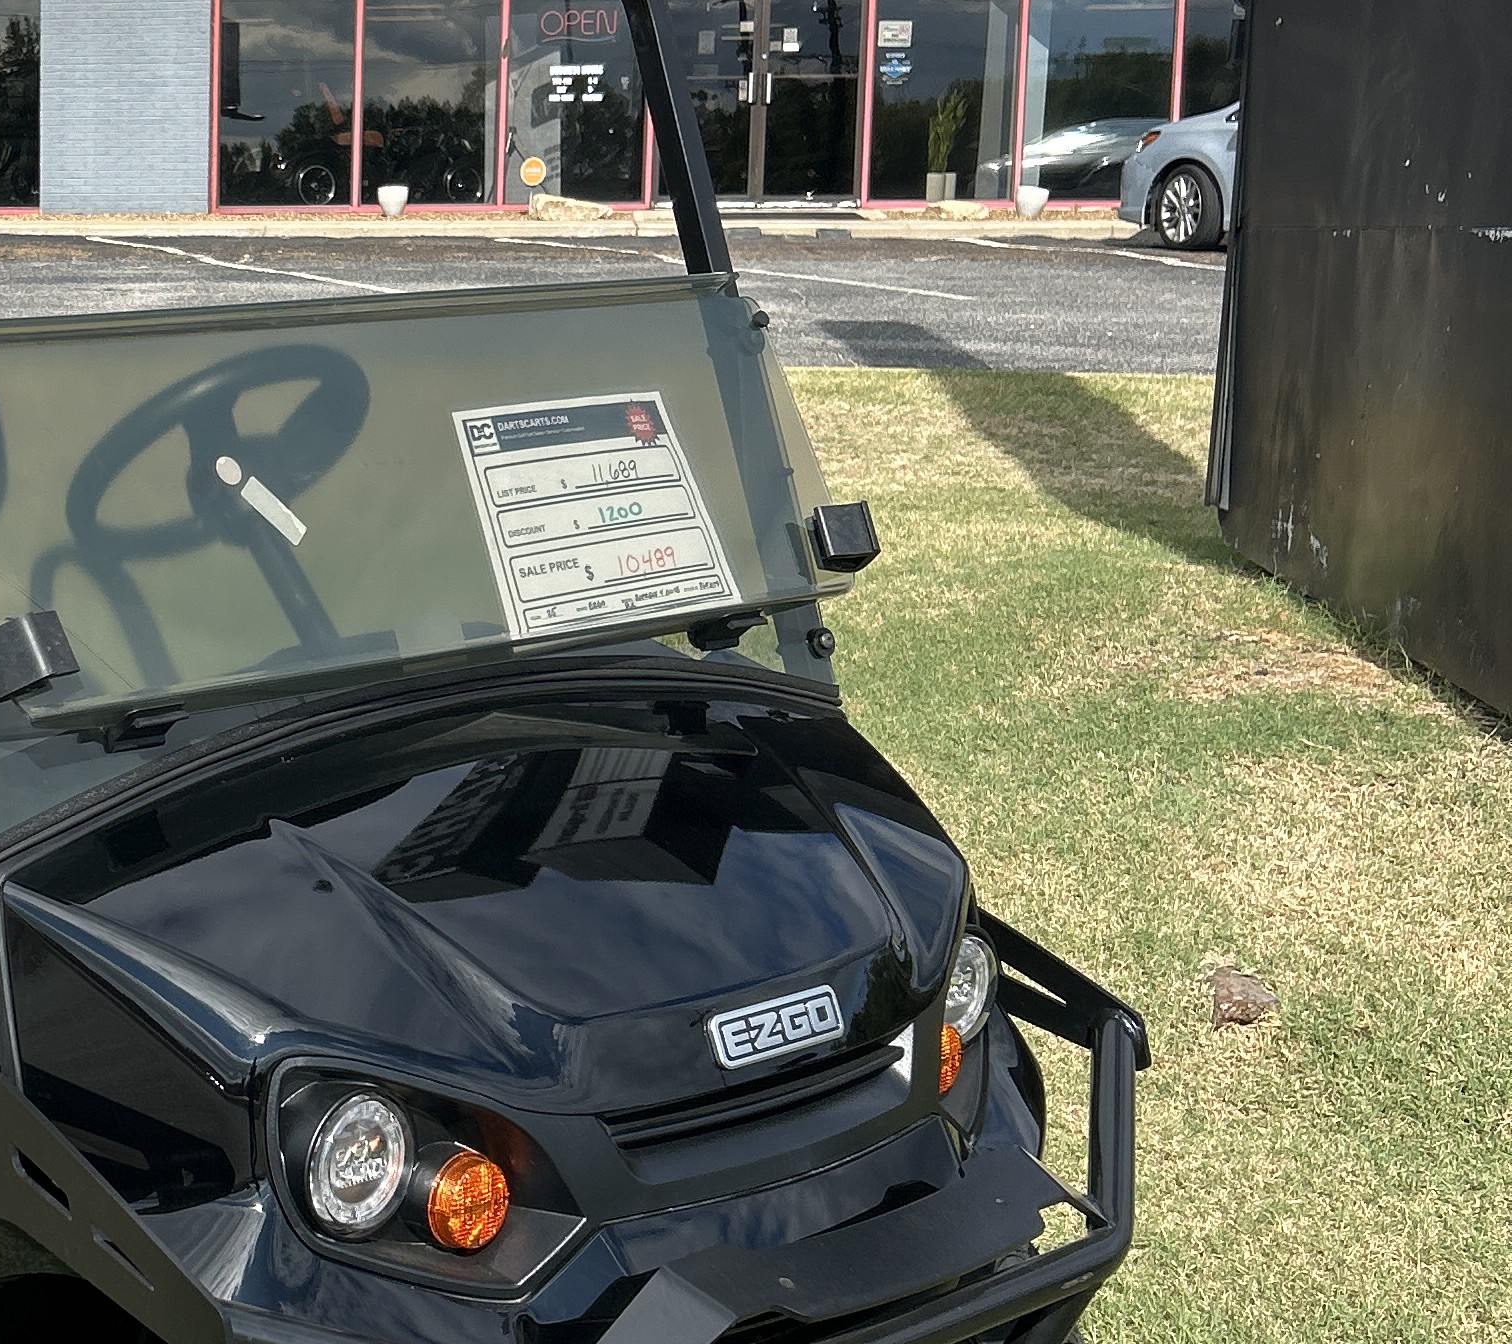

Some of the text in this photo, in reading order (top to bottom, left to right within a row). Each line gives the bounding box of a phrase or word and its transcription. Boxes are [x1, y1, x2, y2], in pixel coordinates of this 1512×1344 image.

[541, 10, 618, 35] OPEN
[497, 415, 569, 431] DARTSCARTS.COM
[497, 488, 513, 498] LIST
[515, 485, 537, 495] PRICE
[508, 524, 546, 538] DISCOUNT
[598, 502, 643, 523] 1200
[519, 564, 547, 578] SALE
[549, 558, 580, 572] PRICE
[584, 565, 595, 581] $
